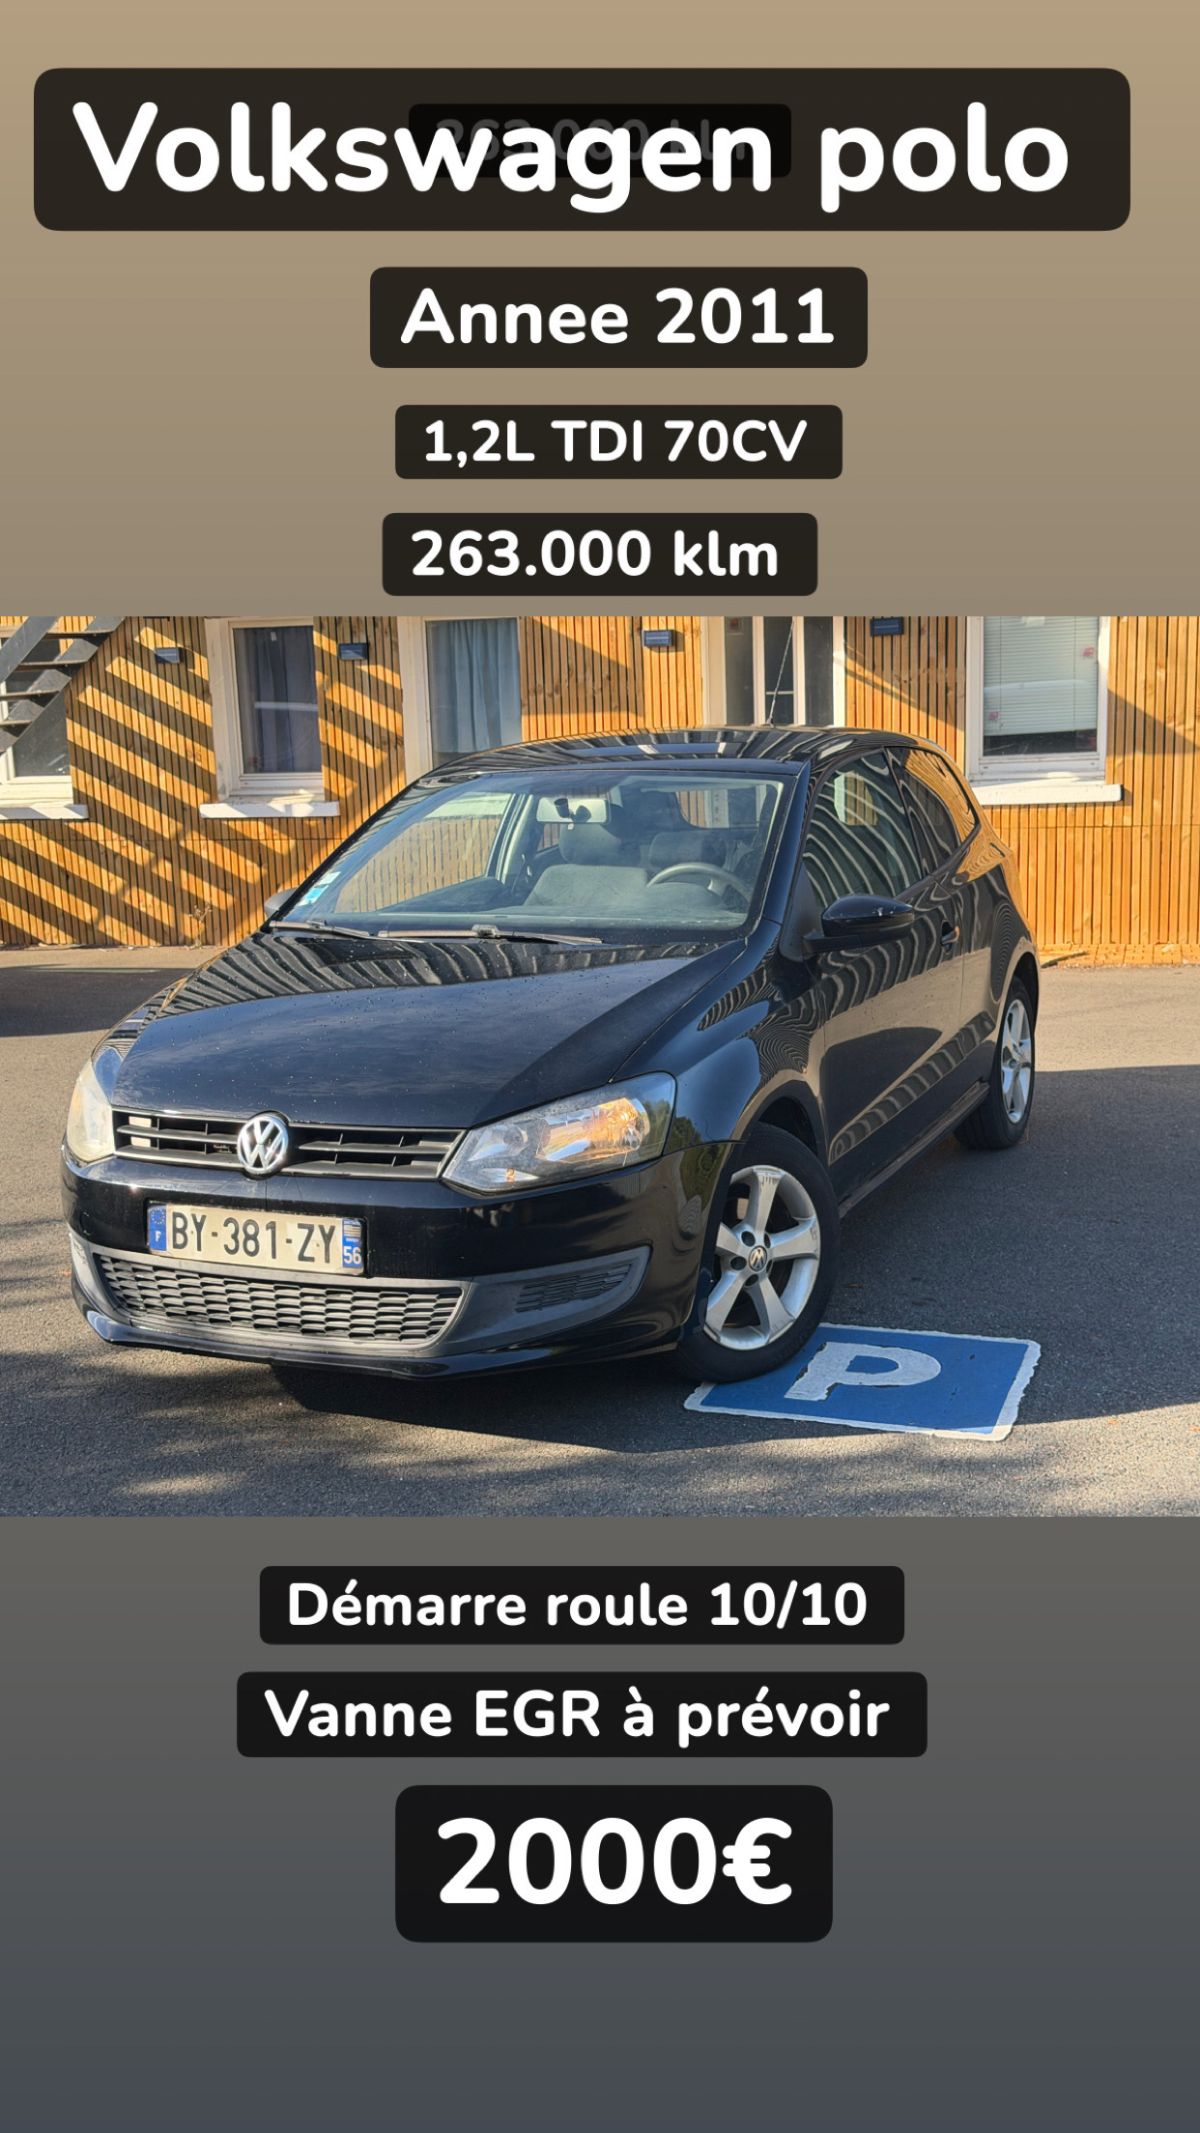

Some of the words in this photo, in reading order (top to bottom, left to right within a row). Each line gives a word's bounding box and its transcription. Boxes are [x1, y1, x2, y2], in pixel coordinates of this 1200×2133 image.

[155, 1230, 161, 1242] F
[172, 1211, 336, 1264] BY-381-ZY
[343, 1245, 361, 1264] 56
[783, 1341, 941, 1402] P
